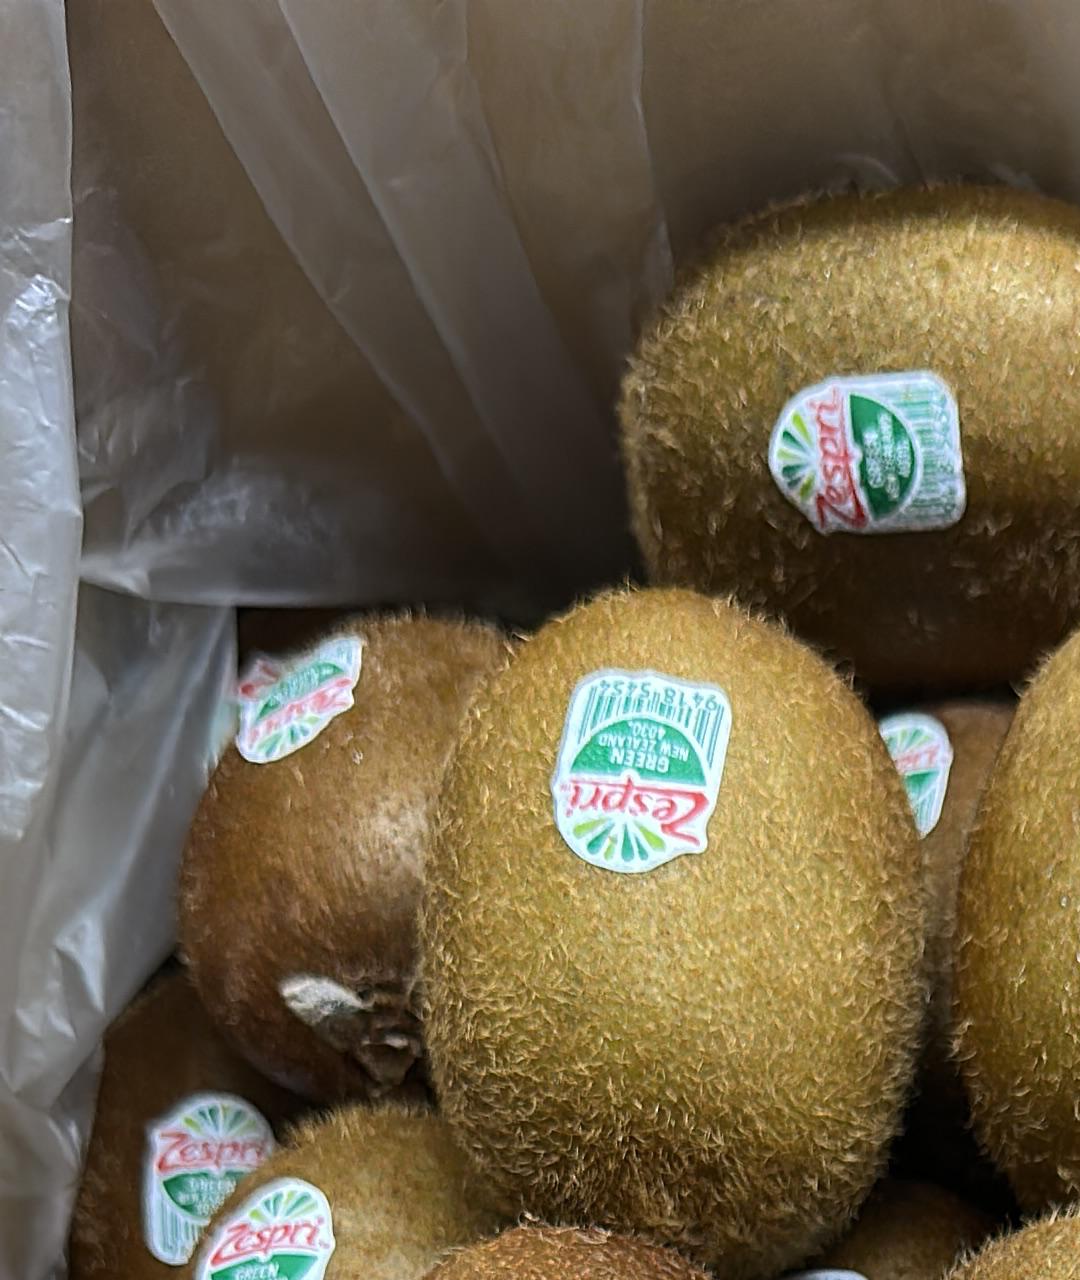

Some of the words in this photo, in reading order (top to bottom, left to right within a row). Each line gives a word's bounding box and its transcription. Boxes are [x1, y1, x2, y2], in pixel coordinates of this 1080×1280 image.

[808, 386, 869, 529] Zespri
[600, 679, 652, 699] 5454
[664, 686, 717, 711] 9418
[609, 750, 671, 773] GREEN
[566, 776, 709, 846] Zespri
[211, 1216, 325, 1267] Zespri
